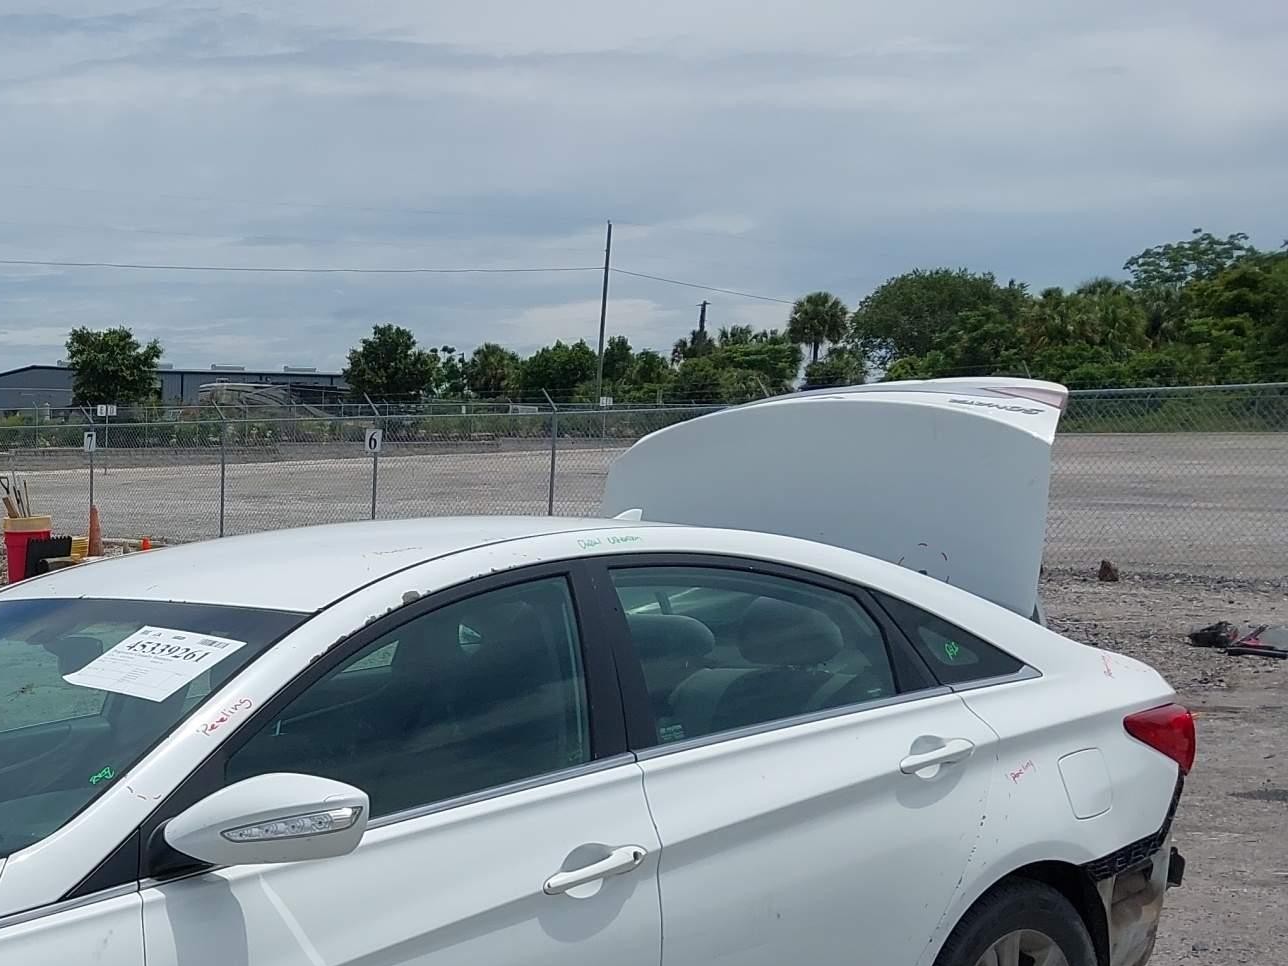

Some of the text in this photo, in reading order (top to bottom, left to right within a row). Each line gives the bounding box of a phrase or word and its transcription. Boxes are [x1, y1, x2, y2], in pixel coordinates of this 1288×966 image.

[87, 434, 93, 450] 7
[368, 431, 378, 450] 6
[127, 640, 212, 663] 45339261
